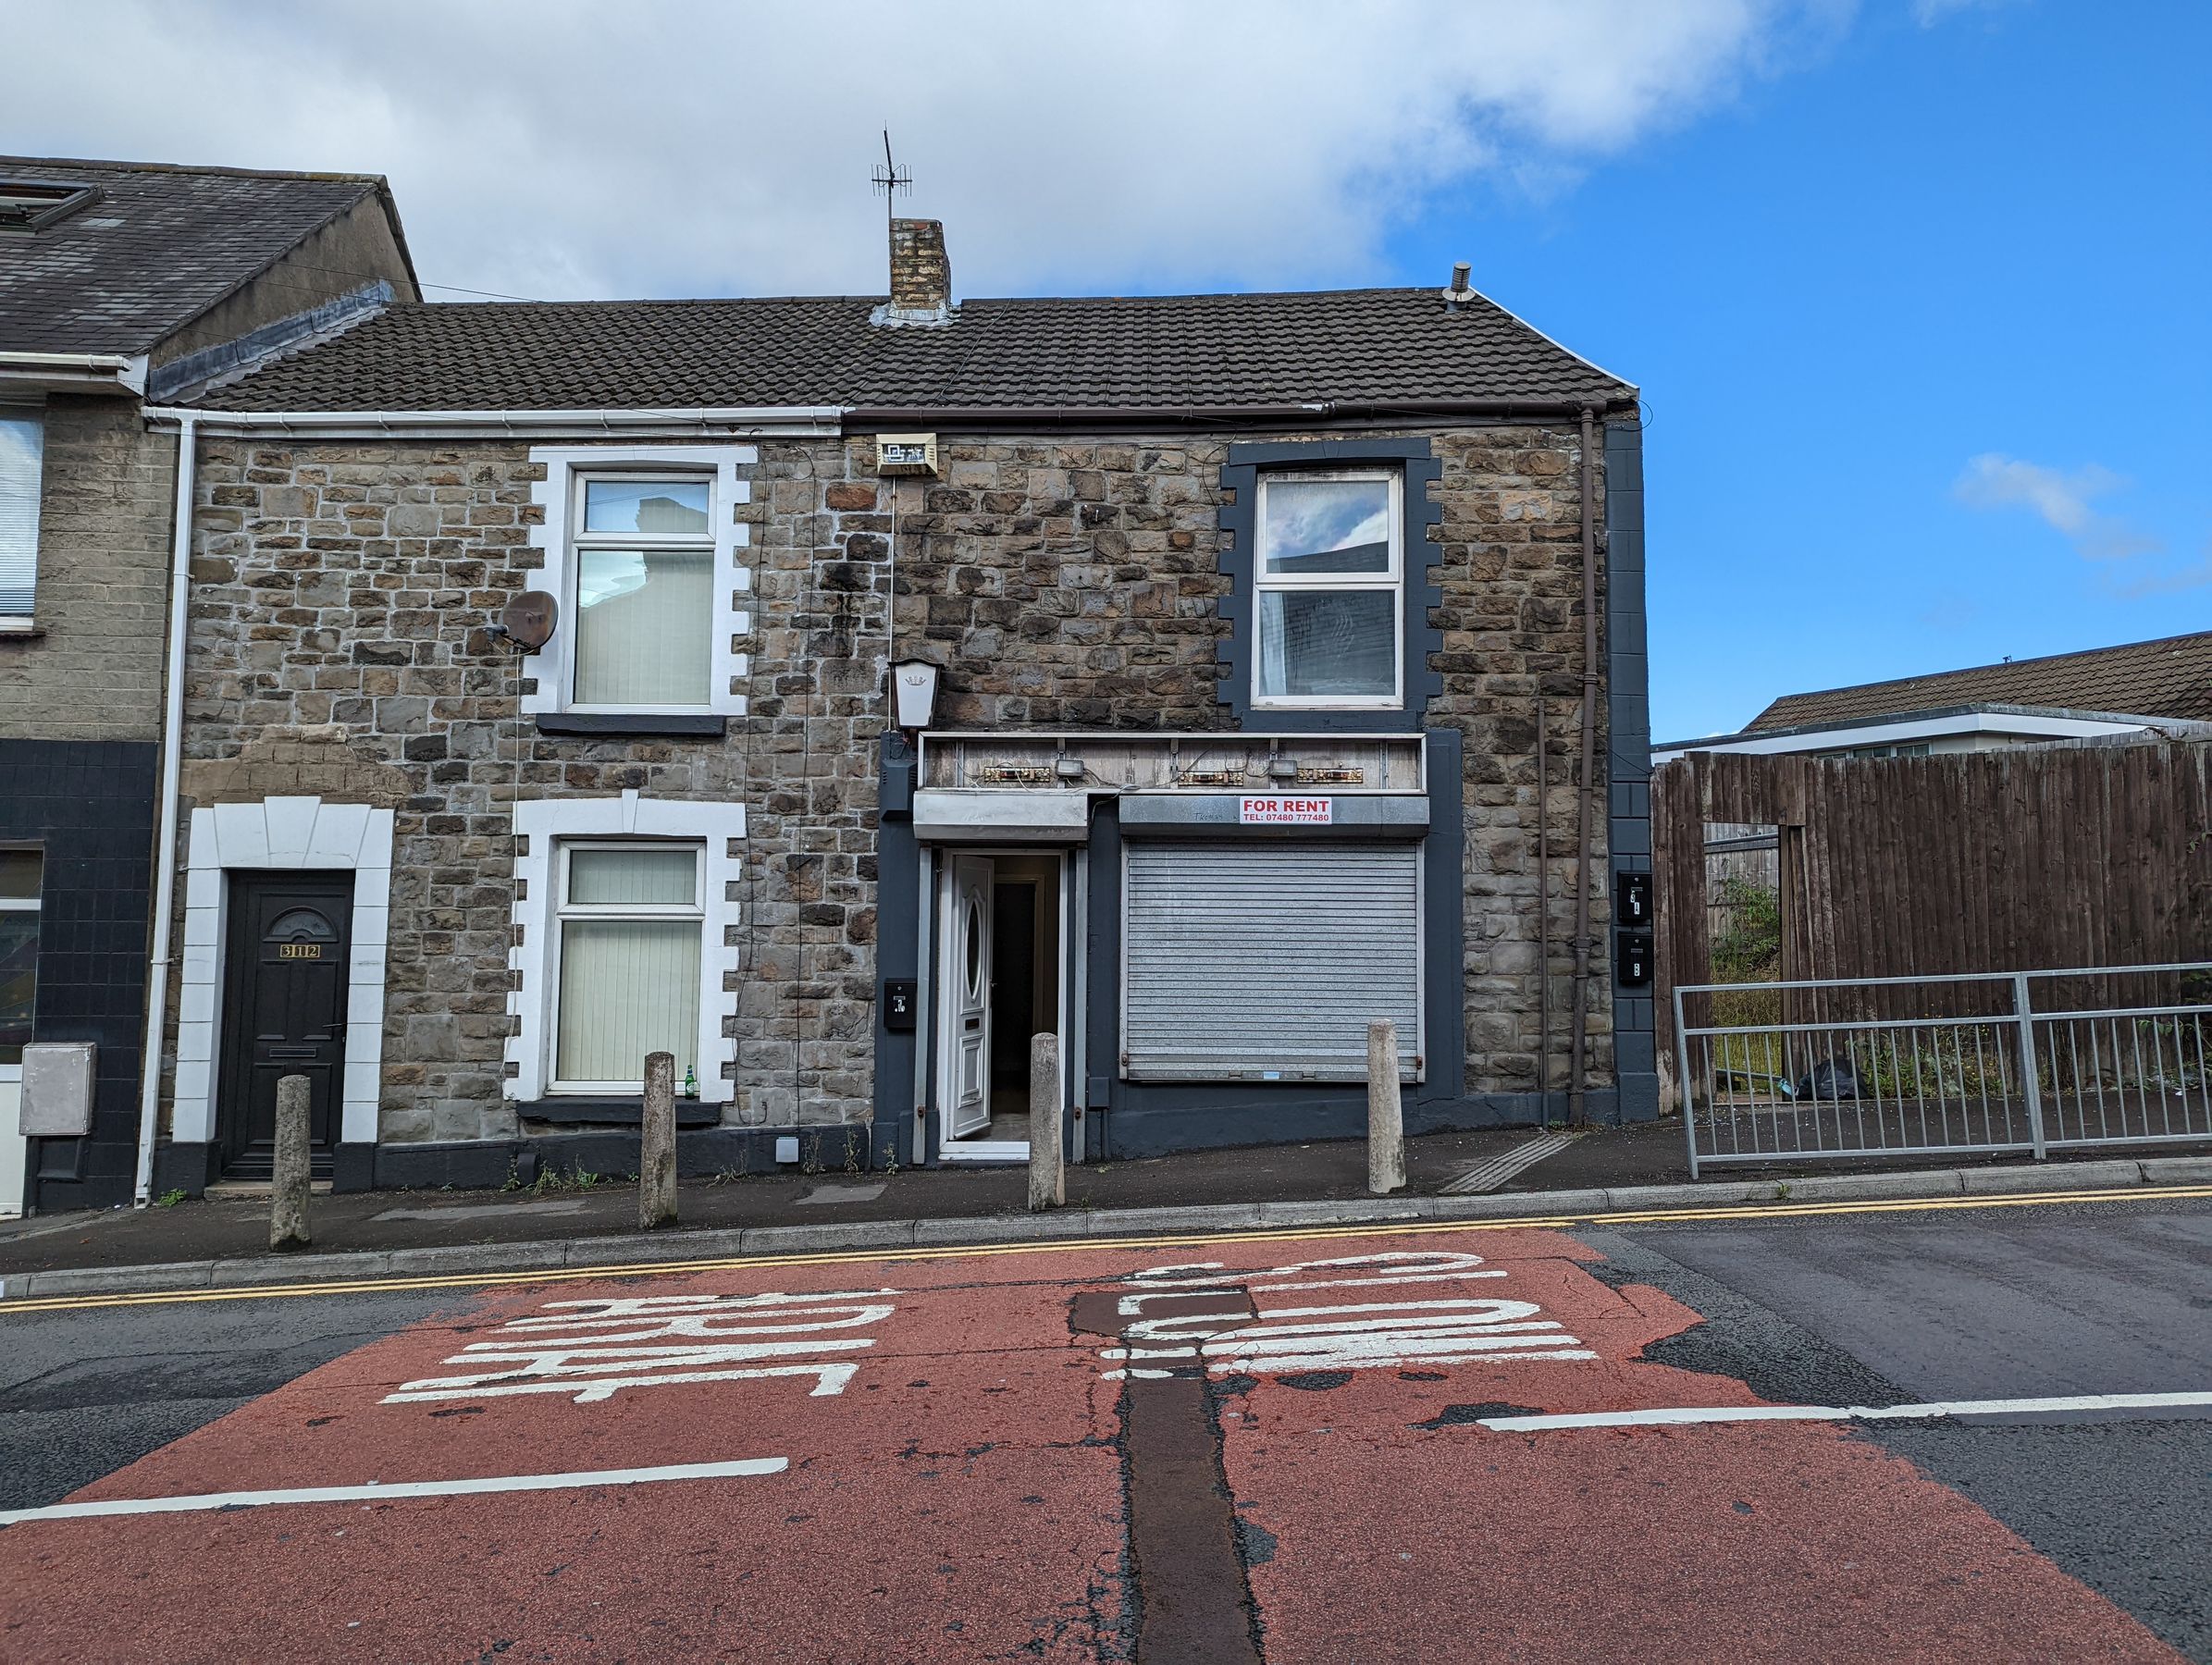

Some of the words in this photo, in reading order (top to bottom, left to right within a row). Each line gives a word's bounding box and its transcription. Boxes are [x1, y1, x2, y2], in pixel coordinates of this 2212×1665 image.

[1243, 800, 1278, 812] FOR
[1283, 800, 1329, 812] RENT
[282, 945, 317, 956] 312
[377, 1288, 906, 1403] ARAF
[1100, 1252, 1599, 1379] SLOW
